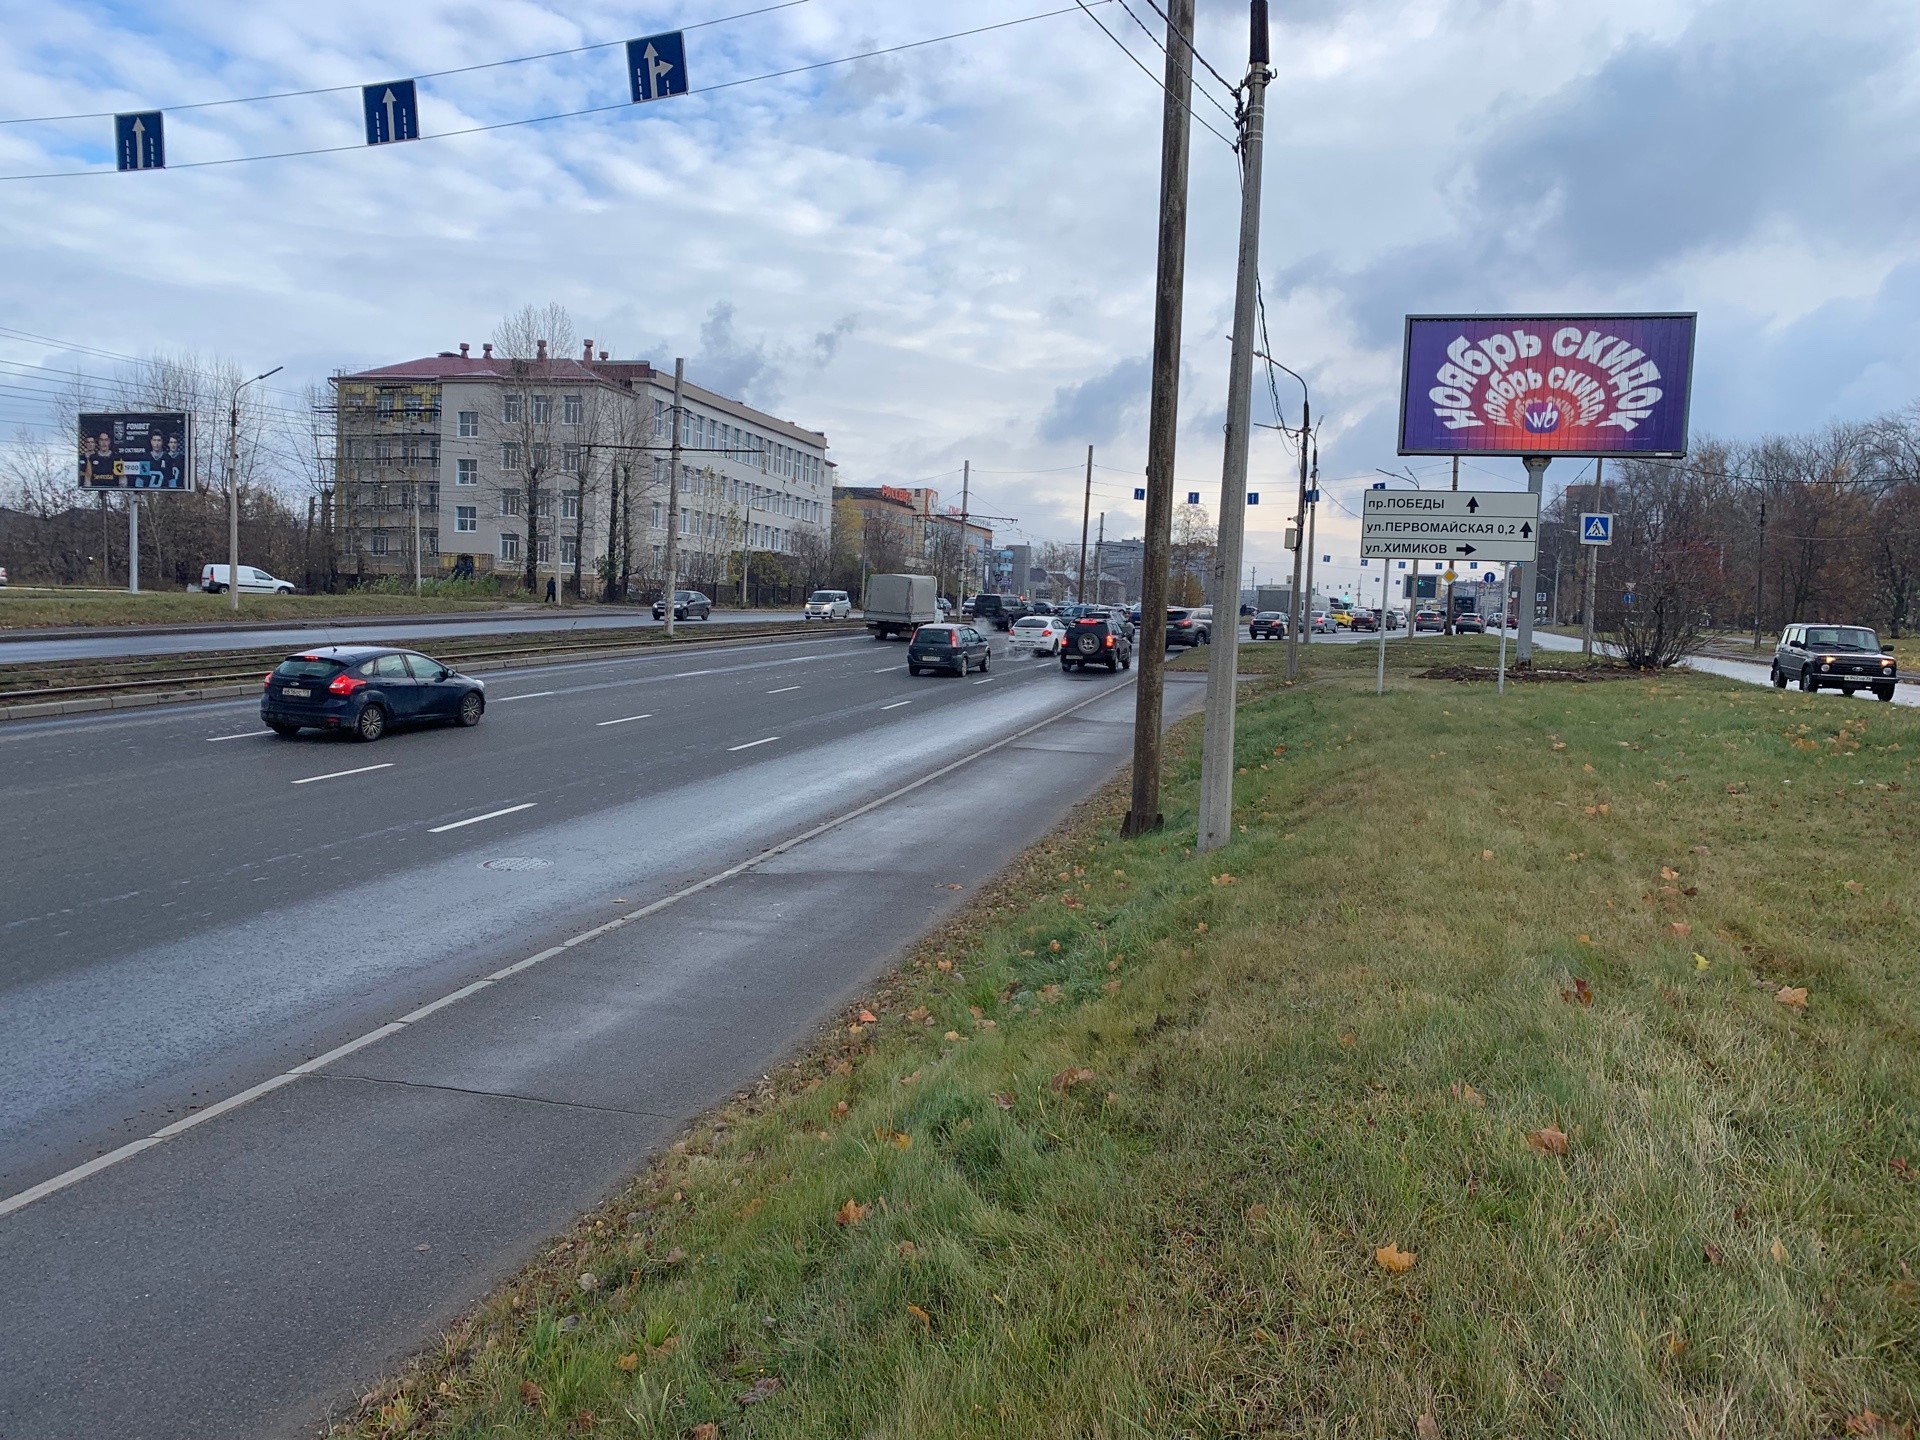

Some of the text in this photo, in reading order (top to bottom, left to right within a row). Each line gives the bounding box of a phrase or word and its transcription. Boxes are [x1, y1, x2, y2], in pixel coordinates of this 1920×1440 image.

[1368, 498, 1445, 510] пр.ПОБЕДЫ
[1366, 521, 1515, 536] ул.ПЕРВОМАЙСКАЯ 0,2
[1365, 543, 1448, 555] ул.ХИМИКОВ
